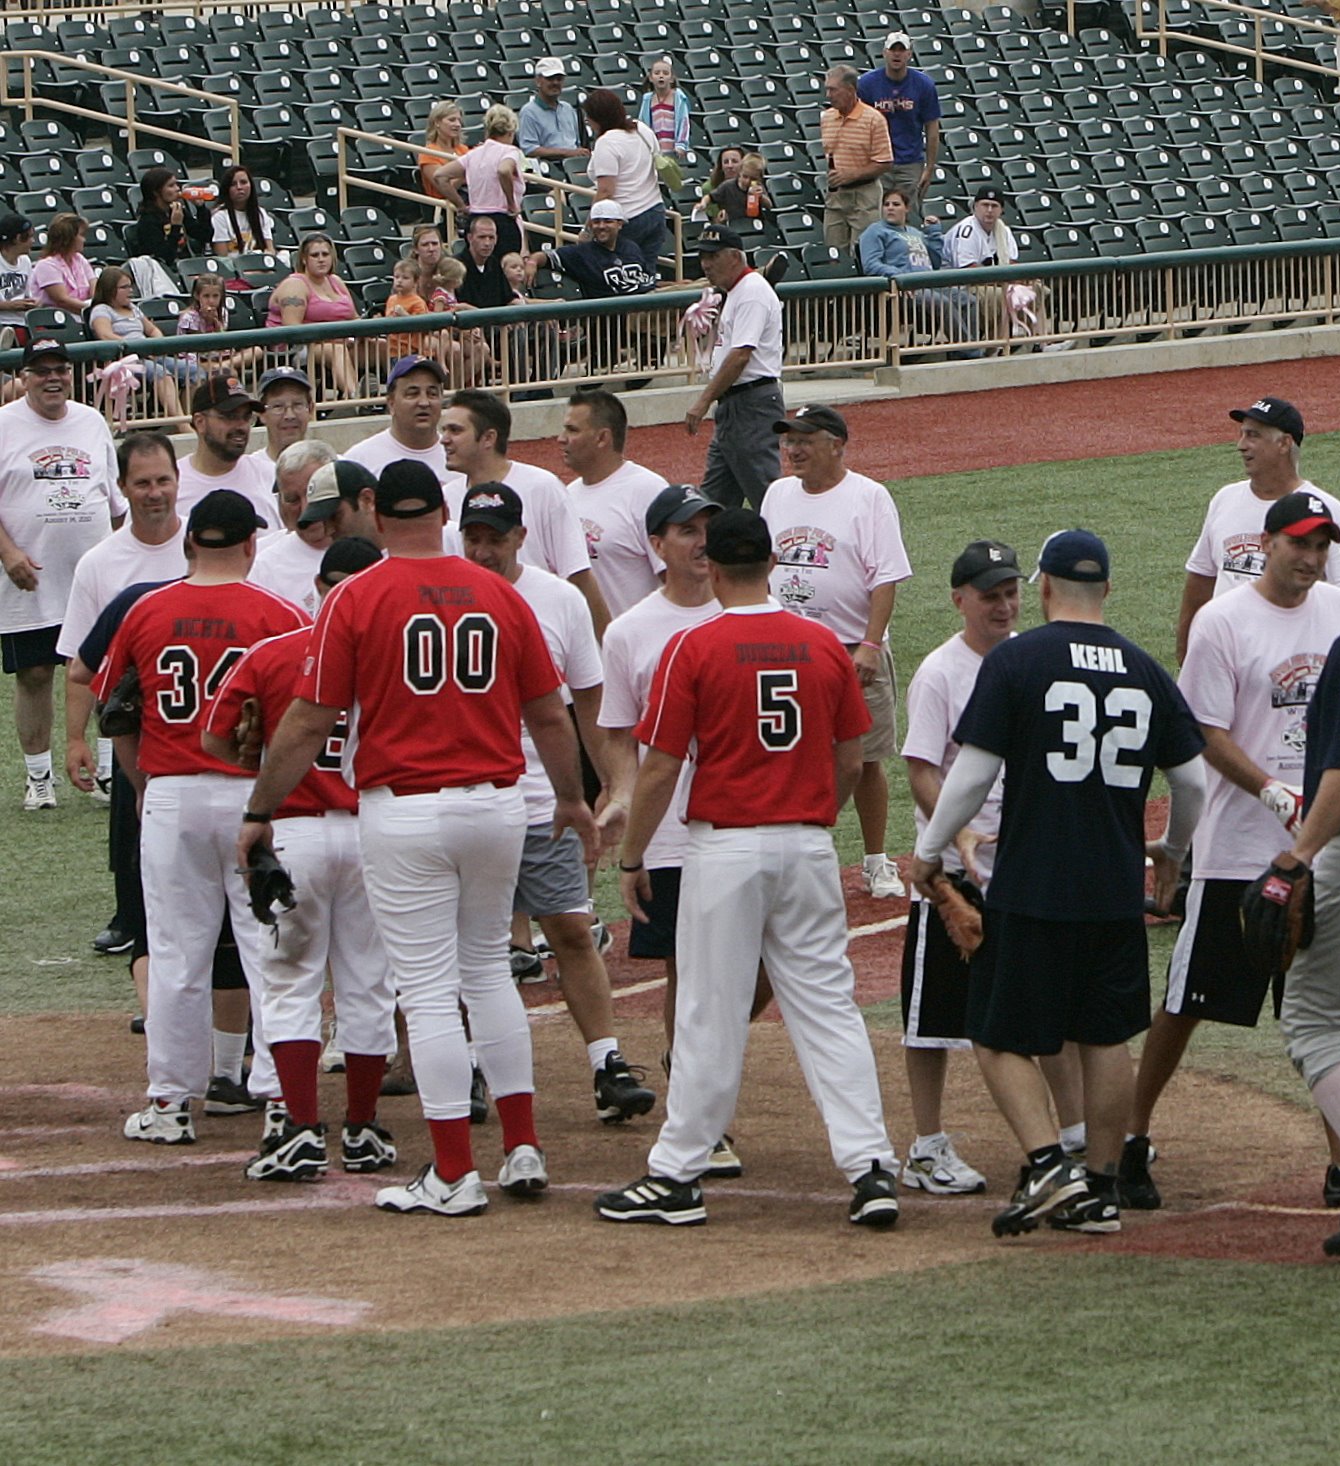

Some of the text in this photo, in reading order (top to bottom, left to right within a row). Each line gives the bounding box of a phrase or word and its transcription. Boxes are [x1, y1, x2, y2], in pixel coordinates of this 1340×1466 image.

[954, 224, 974, 239] 10
[403, 613, 498, 695] 00
[1069, 643, 1127, 673] KEHL
[756, 669, 802, 751] 5
[1044, 681, 1153, 788] 32
